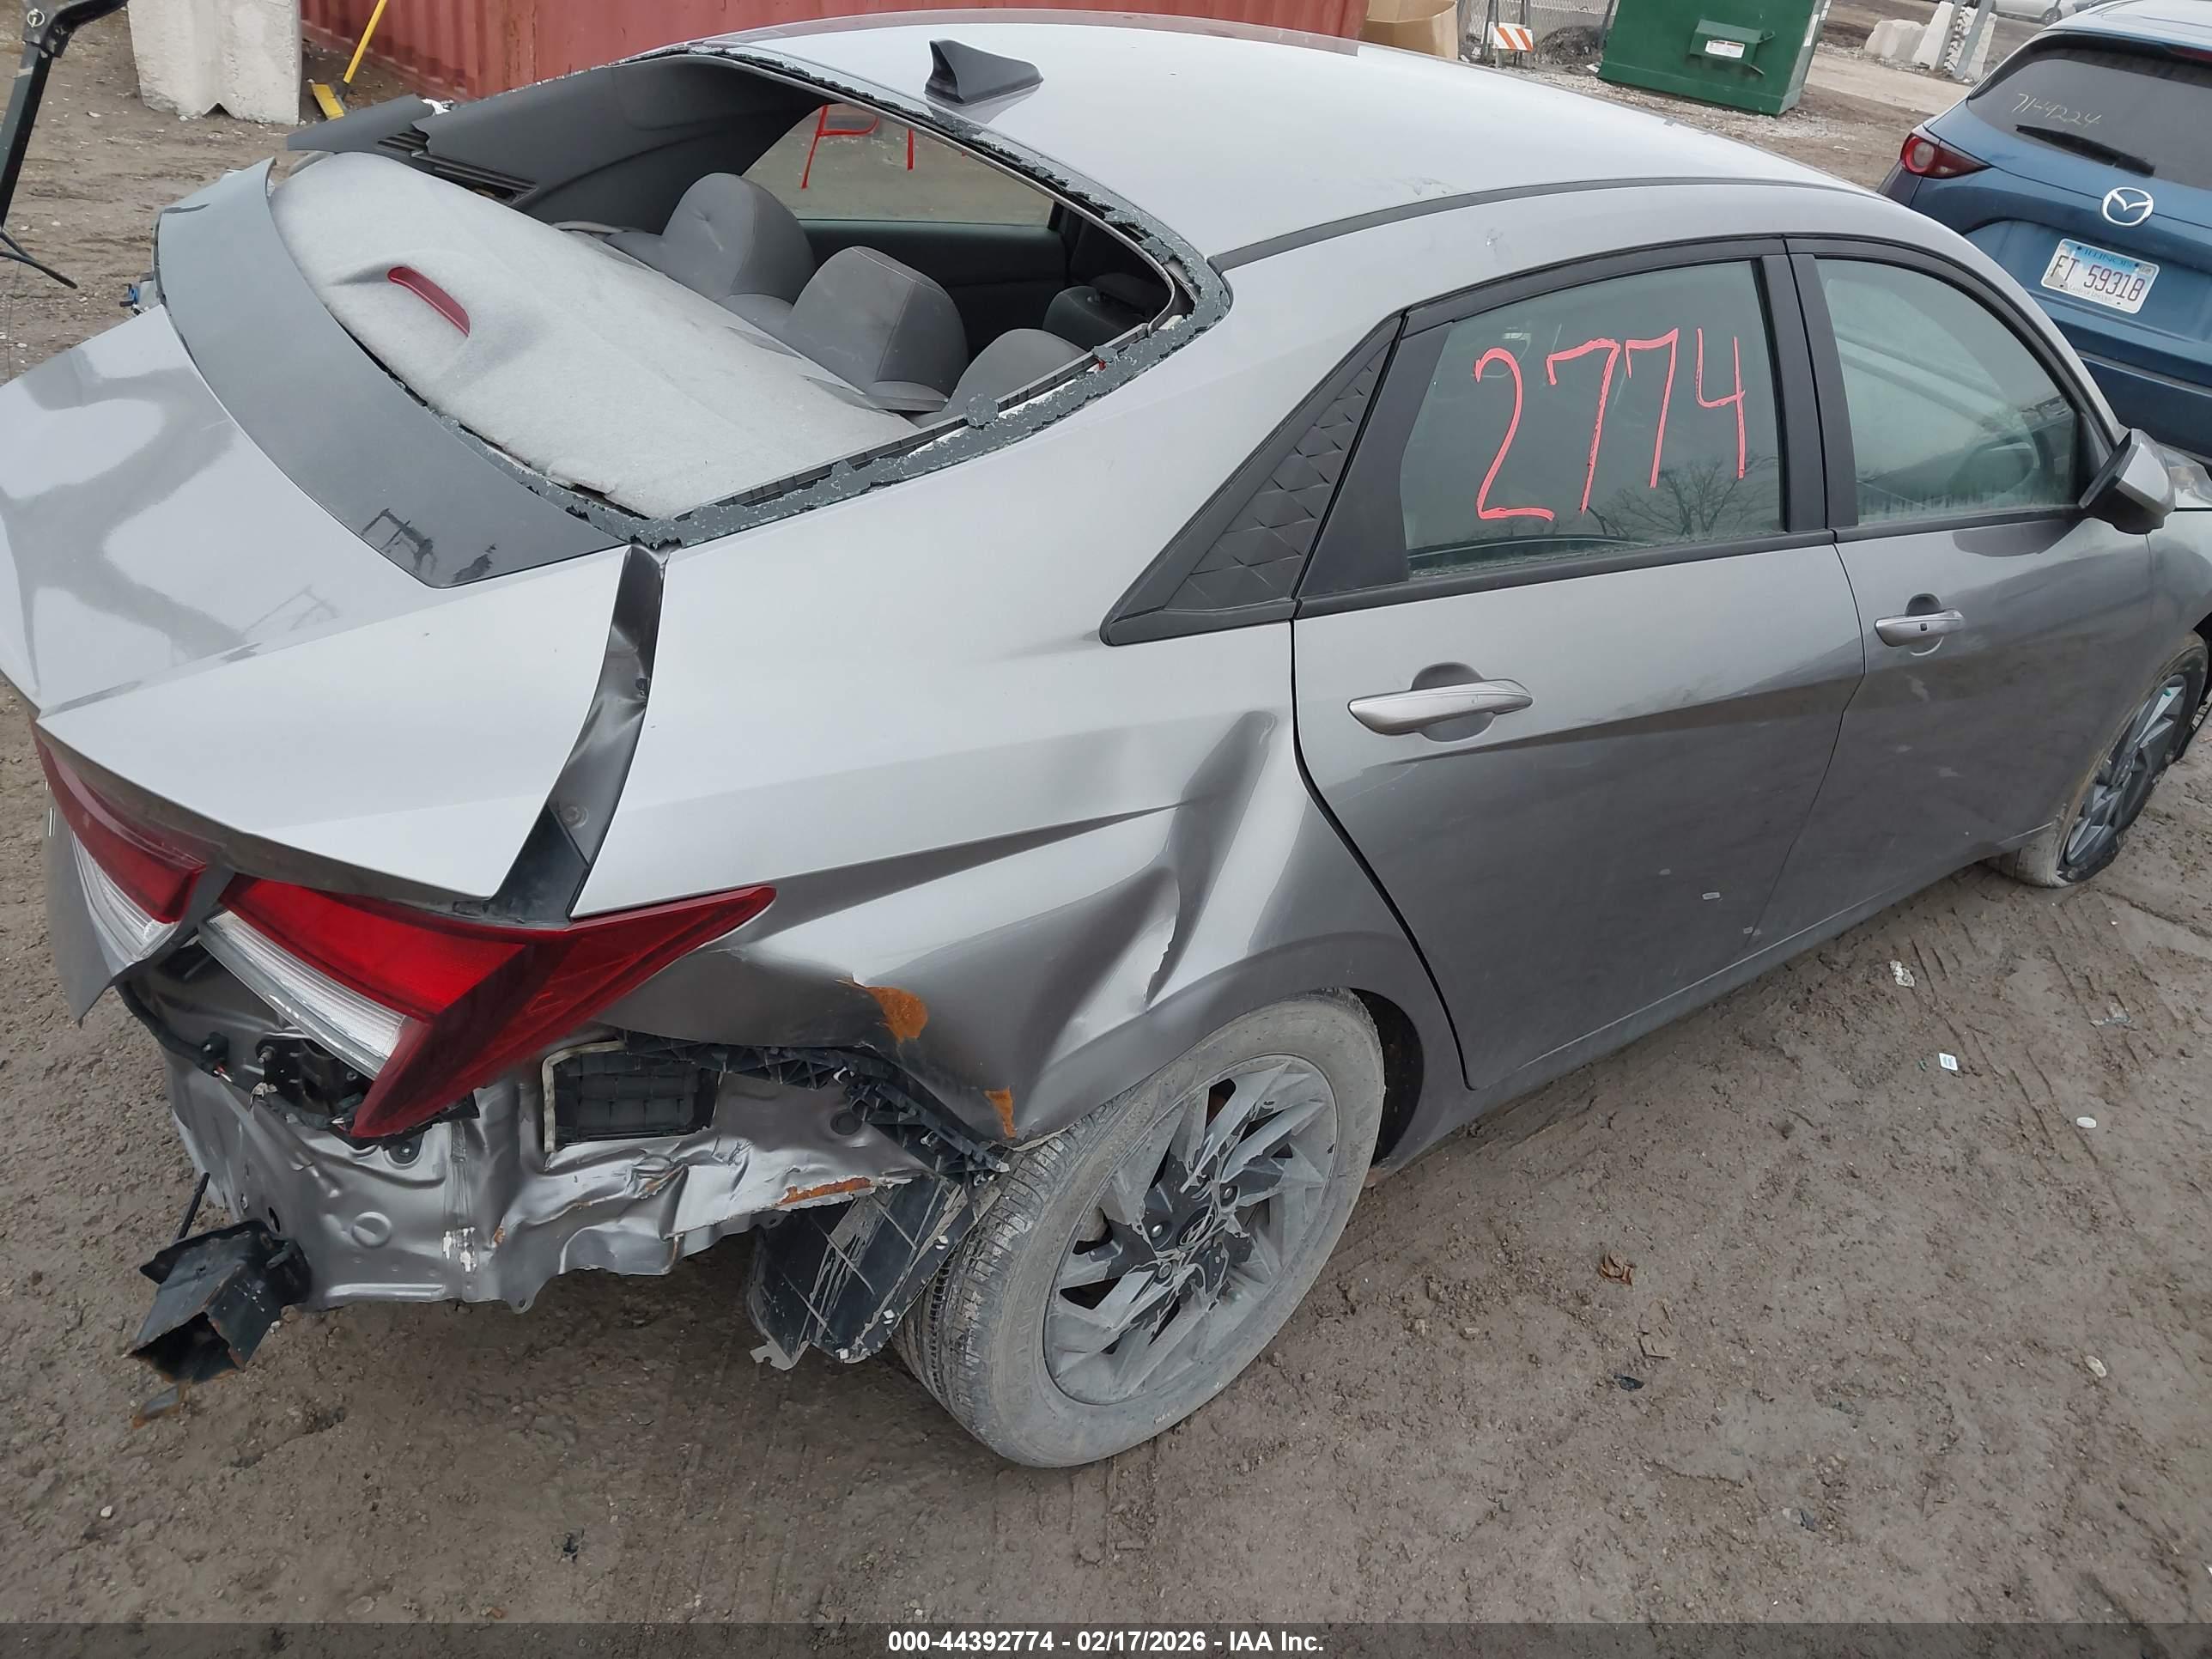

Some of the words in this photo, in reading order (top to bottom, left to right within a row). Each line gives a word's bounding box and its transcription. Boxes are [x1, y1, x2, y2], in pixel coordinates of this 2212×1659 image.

[2050, 254, 2081, 282] FT
[2083, 264, 2146, 302] 59318
[1474, 327, 1746, 521] 2774
